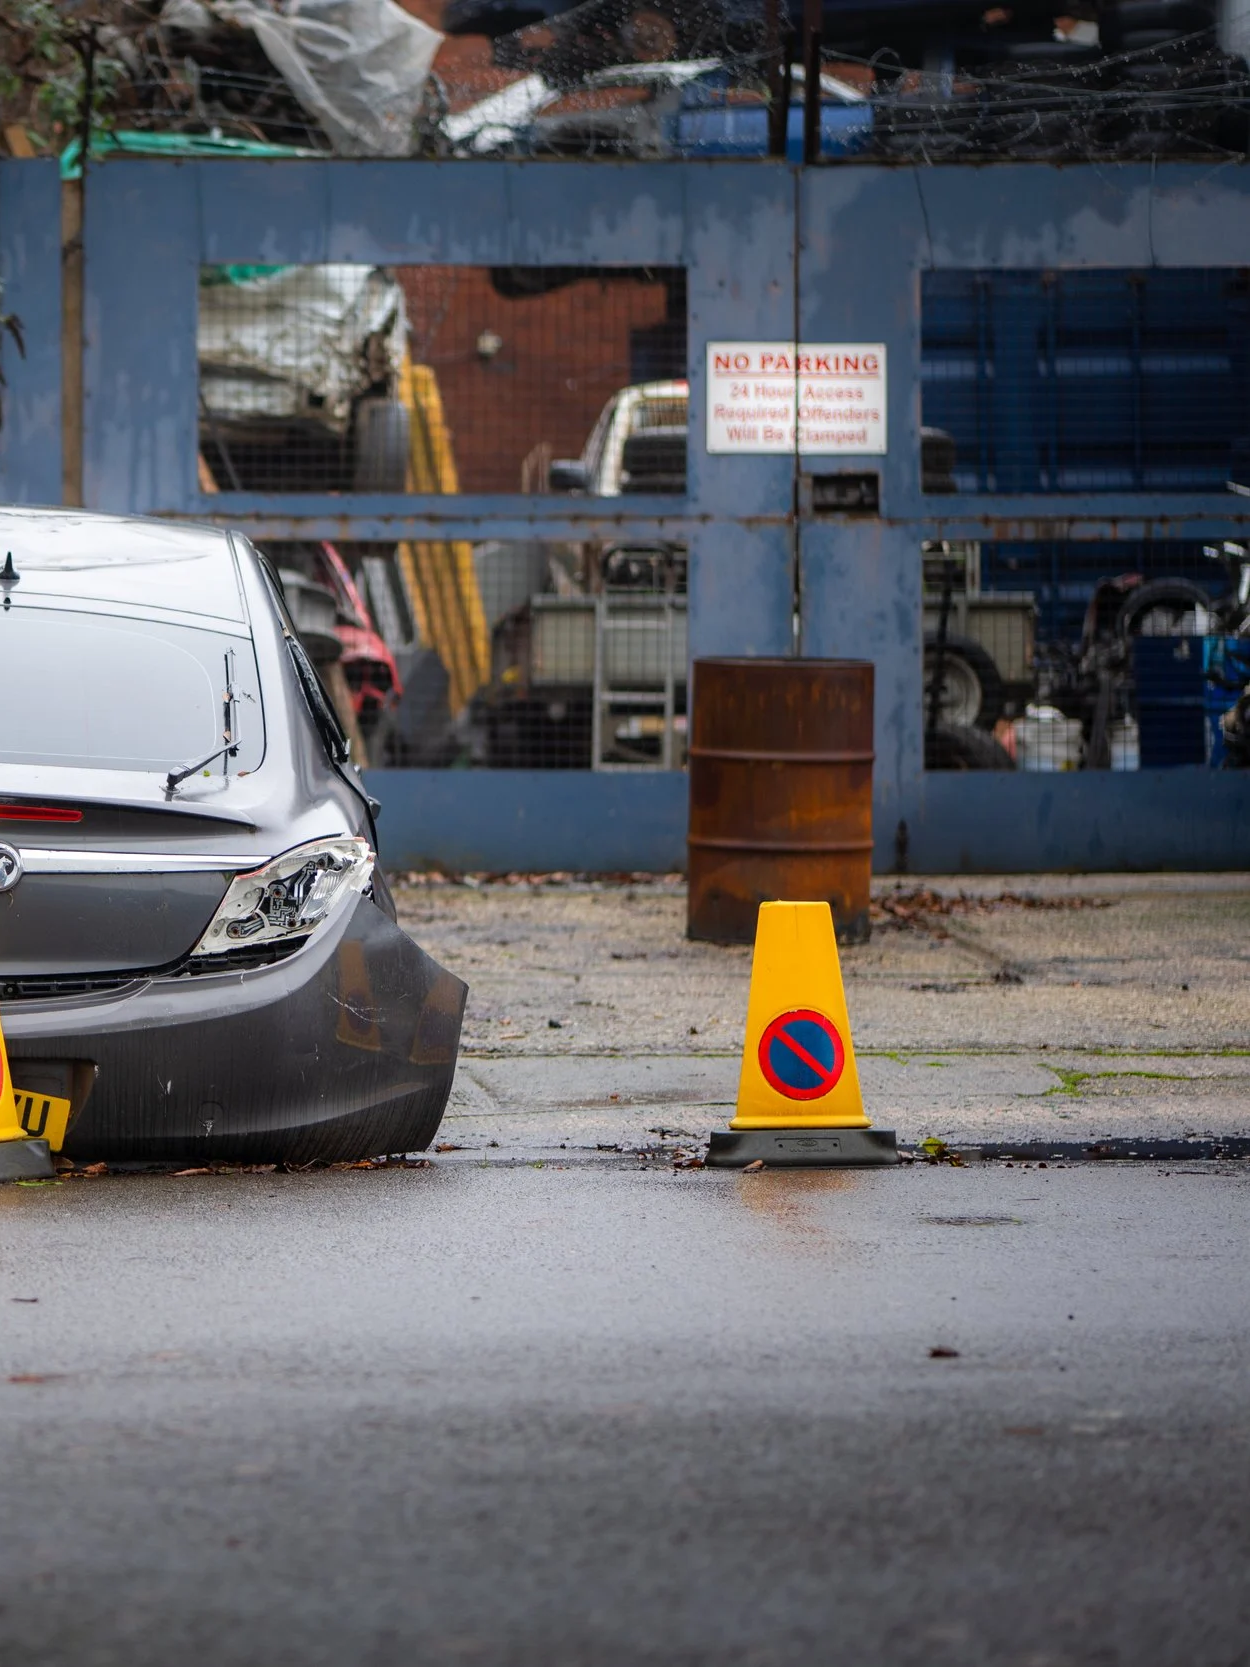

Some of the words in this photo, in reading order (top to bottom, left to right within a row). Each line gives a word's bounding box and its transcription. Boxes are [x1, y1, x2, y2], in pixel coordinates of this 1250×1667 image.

[714, 354, 750, 370] NO
[760, 354, 879, 372] PARKING
[729, 382, 749, 399] 24
[754, 383, 795, 399] Hour
[803, 384, 864, 399] Access
[714, 404, 790, 422] Required
[797, 405, 880, 422] Offenders
[726, 425, 758, 441] Will
[762, 426, 784, 441] Be
